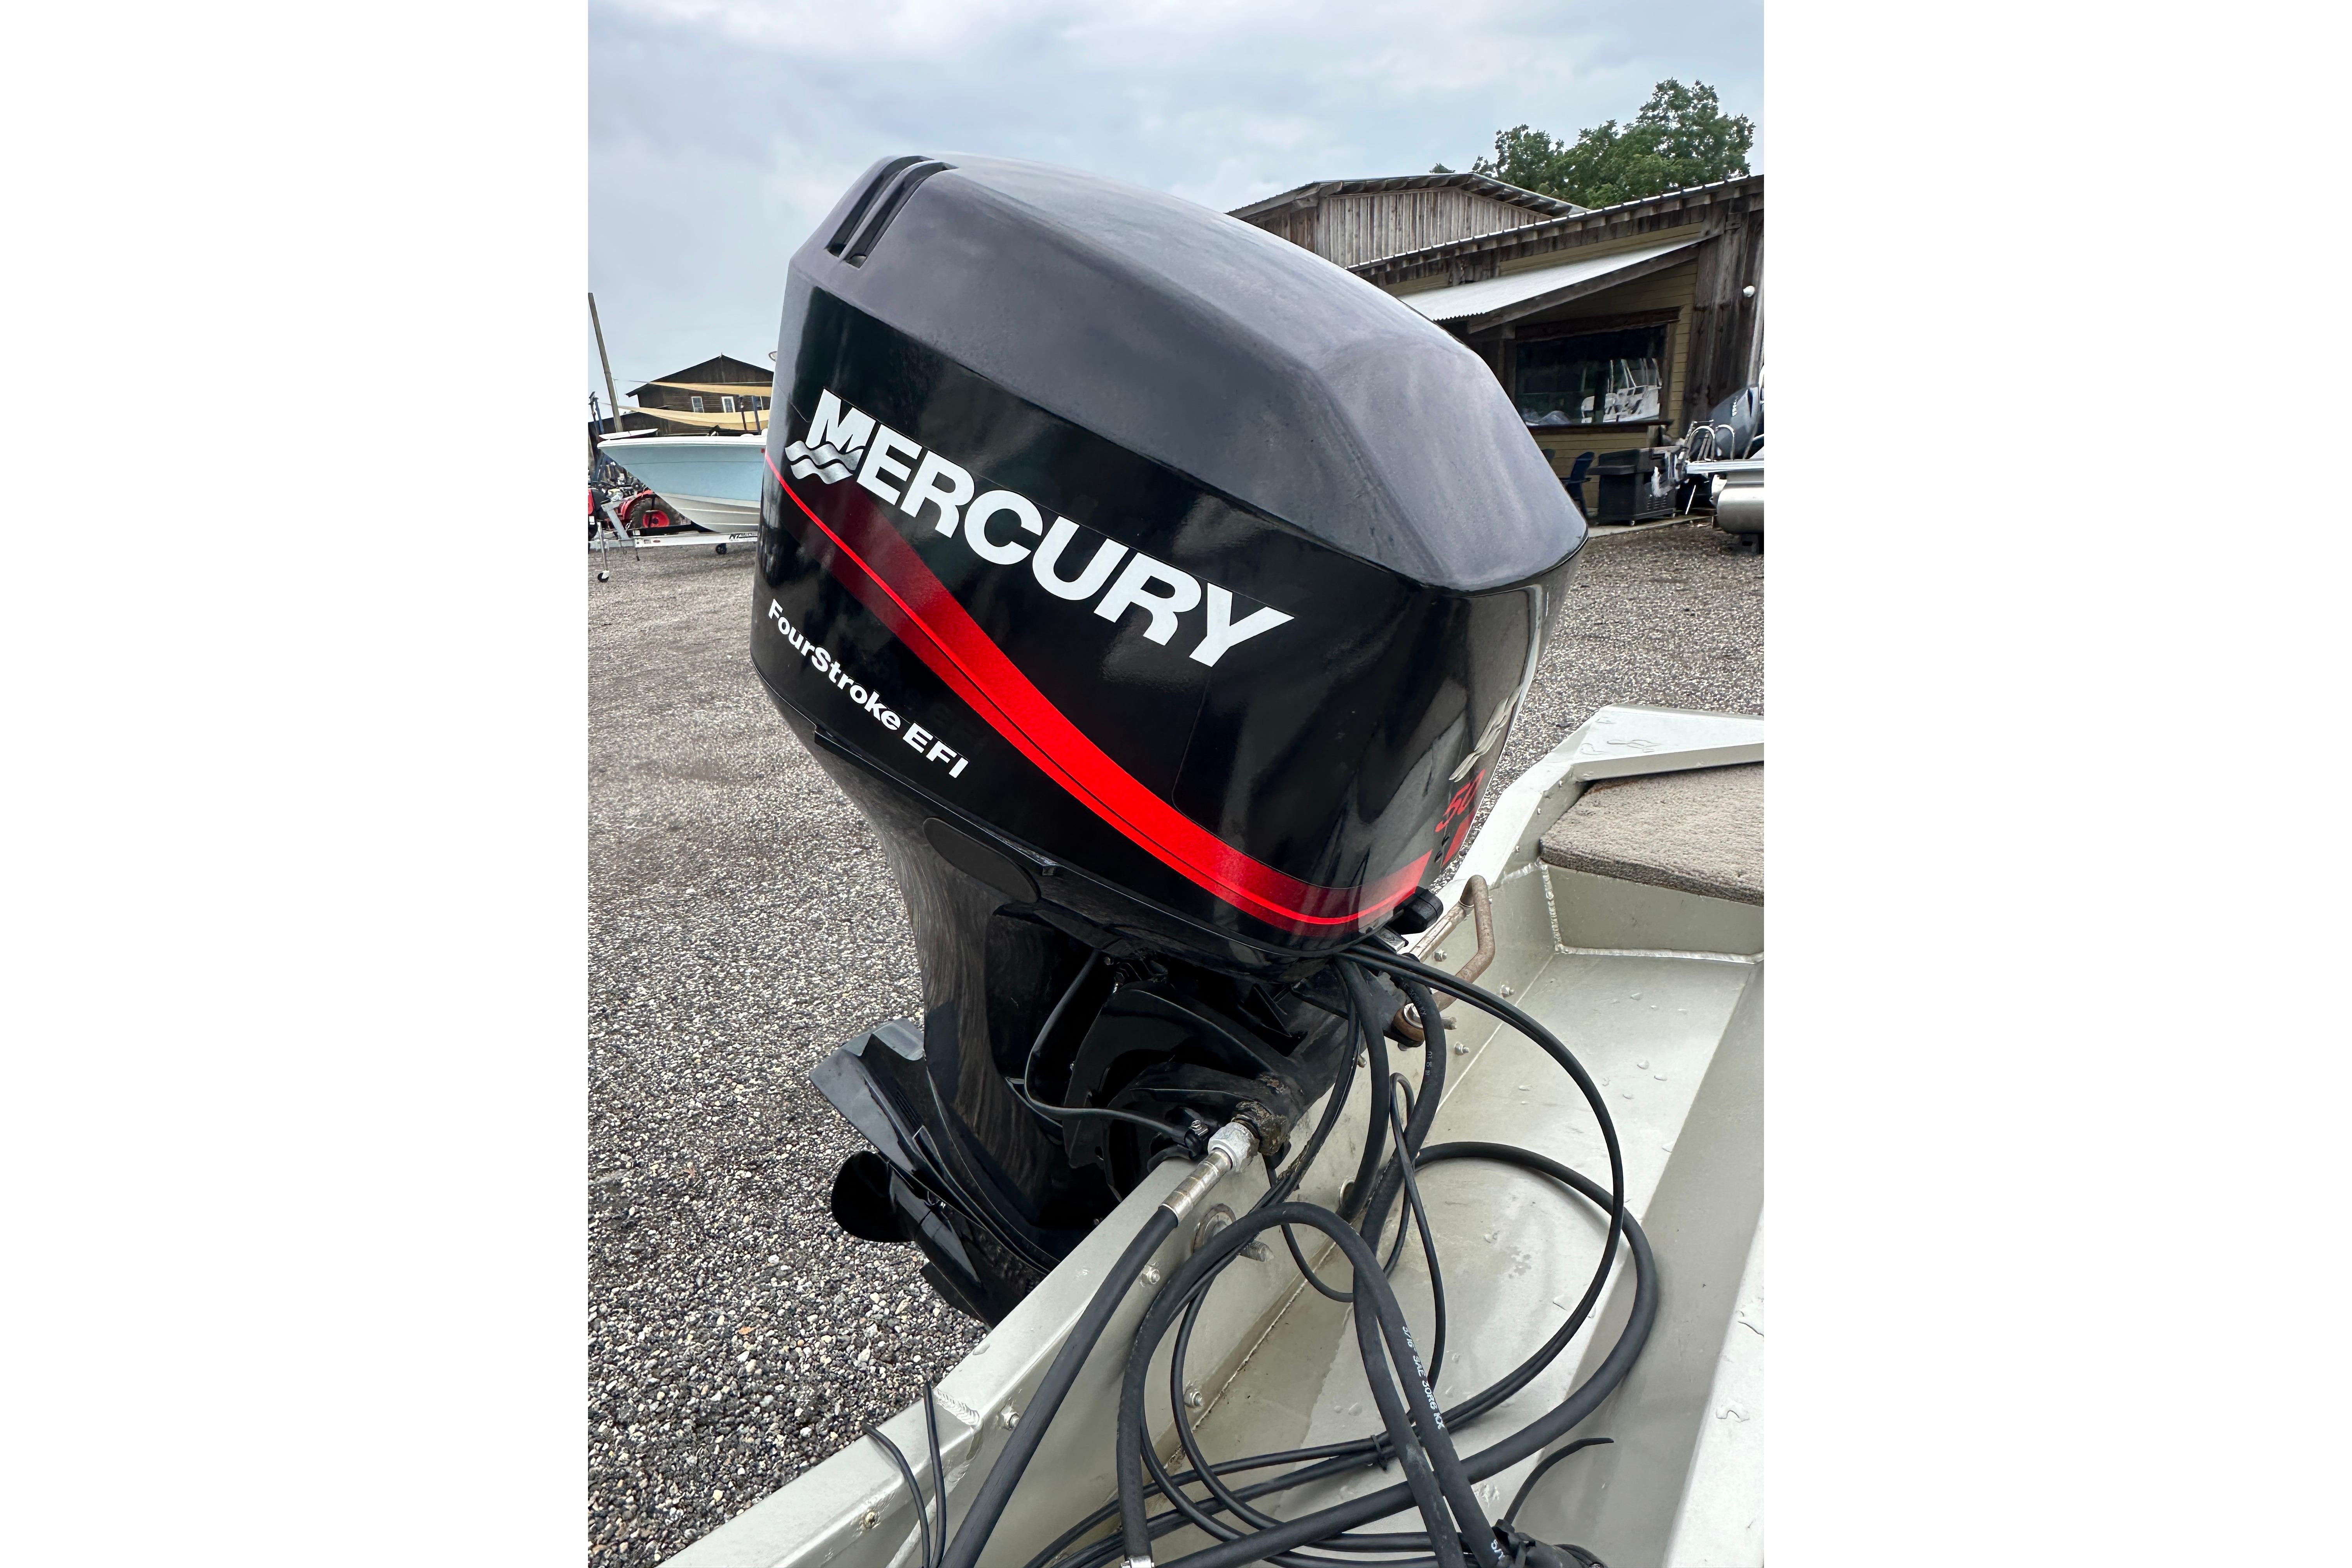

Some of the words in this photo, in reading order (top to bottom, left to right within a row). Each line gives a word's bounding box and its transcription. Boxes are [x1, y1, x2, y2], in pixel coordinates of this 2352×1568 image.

[803, 388, 1295, 668] MERCURY
[768, 598, 901, 731] FourStroke
[902, 722, 970, 778] EFI
[1412, 1355, 1426, 1377] SAE
[1433, 1412, 1445, 1430] KX
